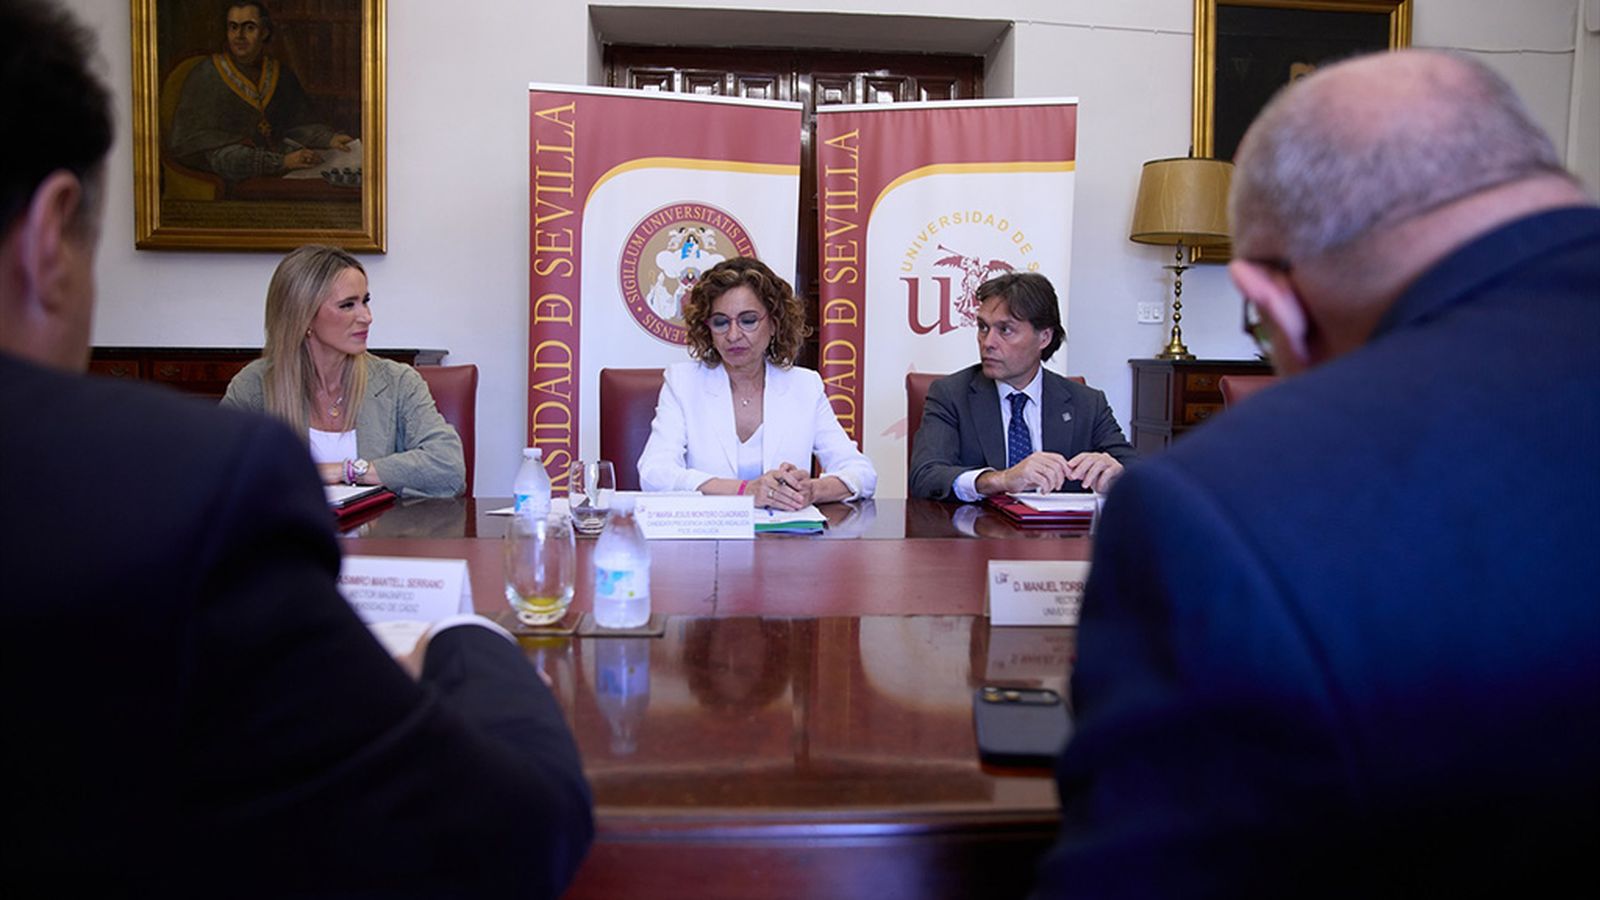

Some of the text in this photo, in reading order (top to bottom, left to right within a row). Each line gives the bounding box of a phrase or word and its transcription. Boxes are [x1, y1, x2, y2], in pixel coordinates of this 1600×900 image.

[534, 101, 576, 278] SEVILLA
[823, 128, 859, 284] SEVILLA
[623, 234, 646, 304] SIGILLUM
[644, 205, 741, 239] UNIVERSITATIS
[901, 210, 1040, 272] UNIVERSIDAD DE S
[407, 577, 445, 590] SERRANO
[1023, 581, 1059, 592] MANUEL
